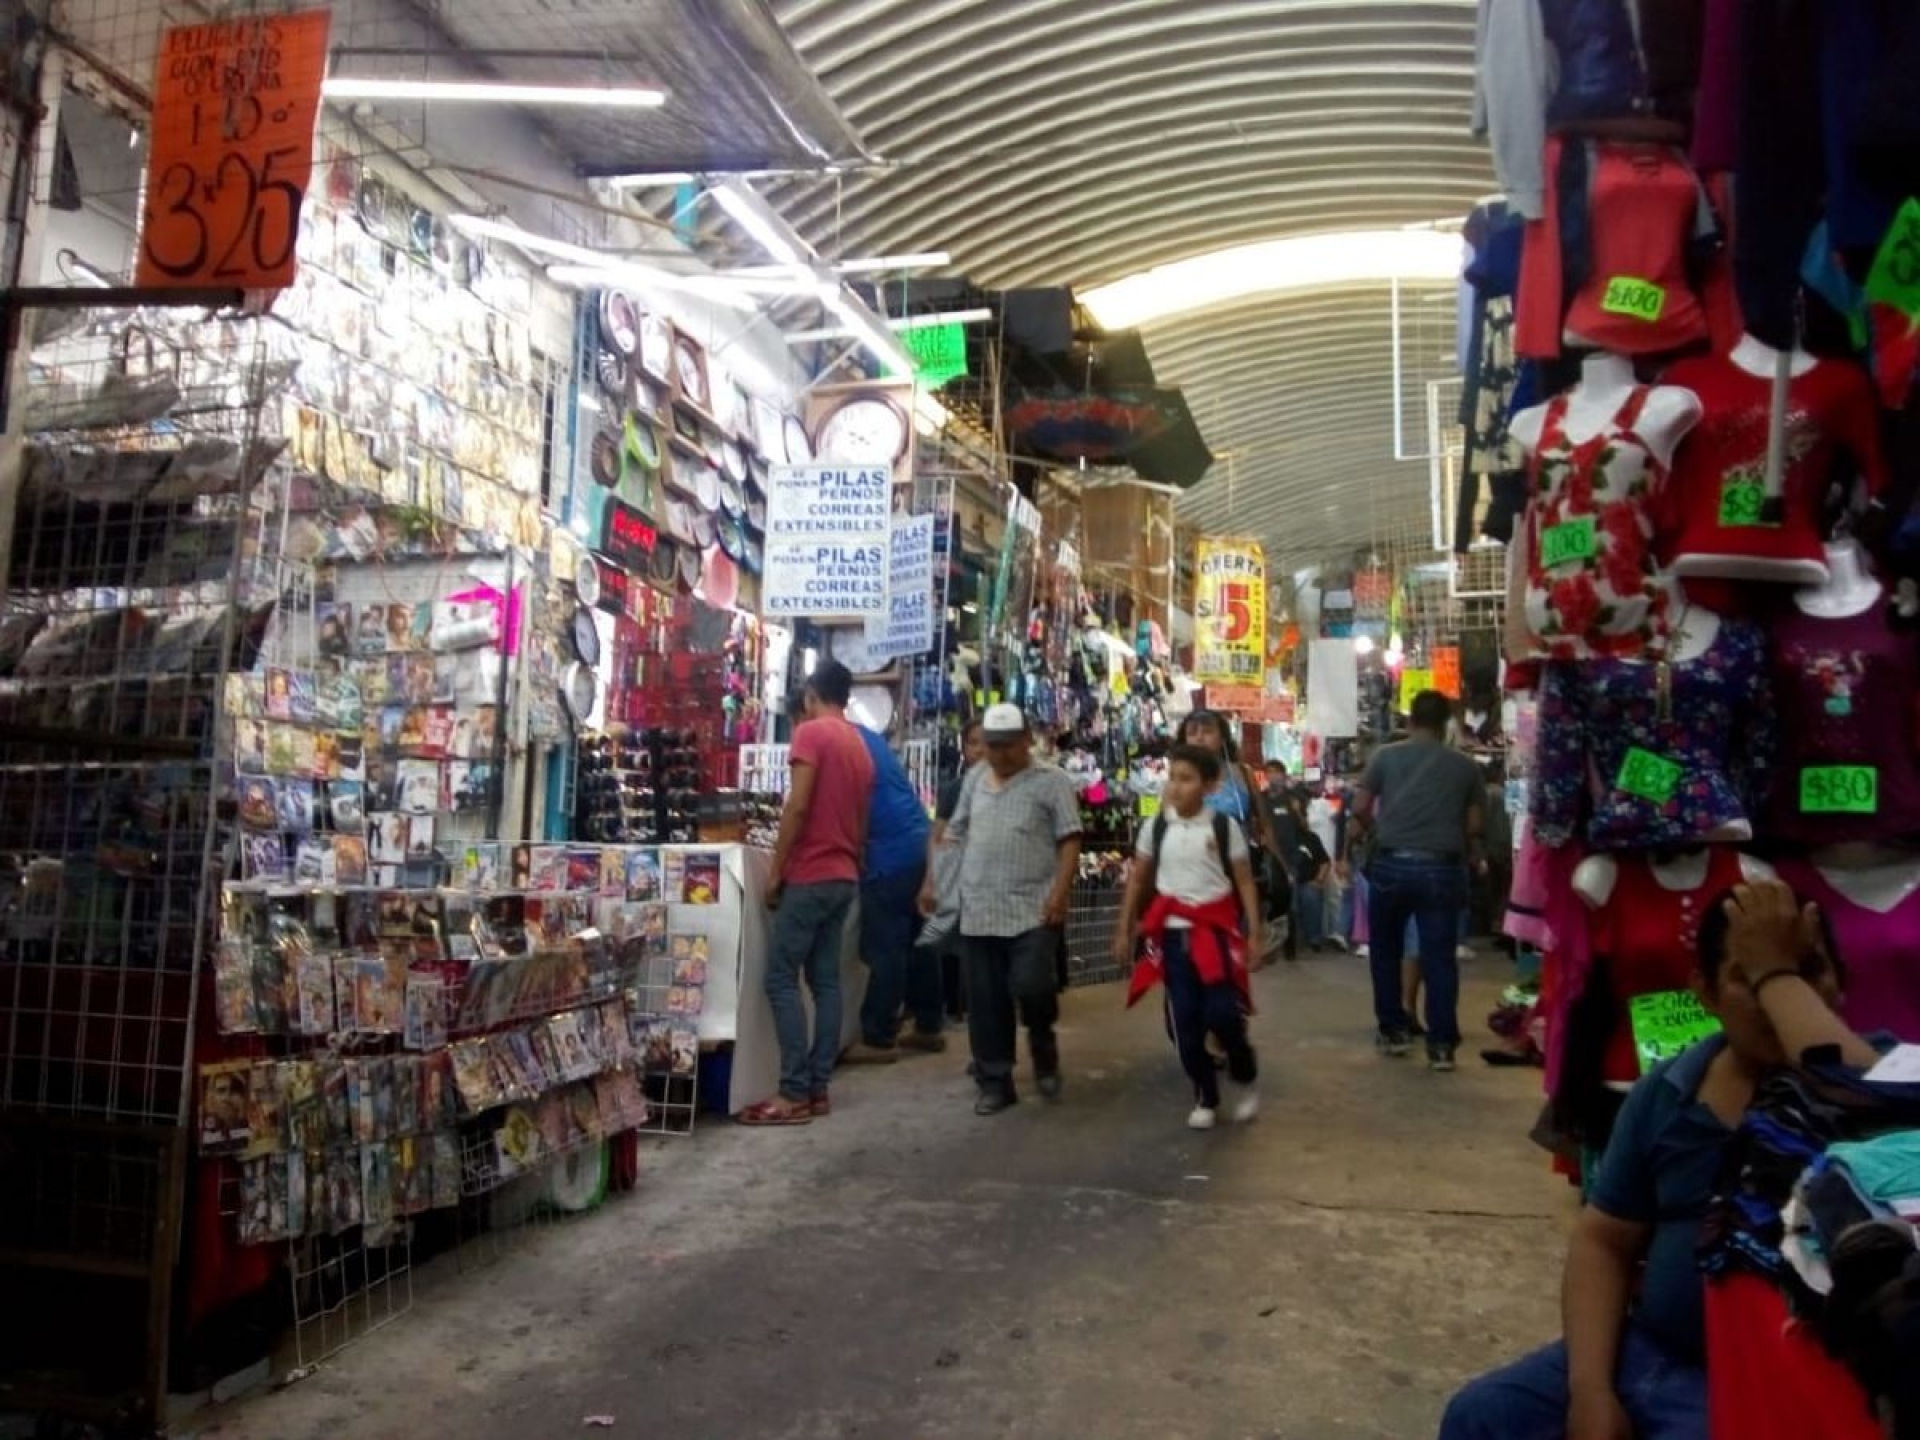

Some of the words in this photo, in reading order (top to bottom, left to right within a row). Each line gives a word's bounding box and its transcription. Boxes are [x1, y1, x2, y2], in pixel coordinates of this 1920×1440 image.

[819, 471, 885, 486] PILAS
[819, 487, 884, 500] PERNOS
[807, 503, 884, 516] CORREAS
[774, 520, 884, 532] EXTENSIBLES
[817, 547, 882, 563] PILAS
[816, 565, 882, 576] PERNOS
[804, 580, 883, 592] CORREAS
[770, 597, 882, 609] EXTENSIBLES
[1214, 582, 1250, 641] 5
[1804, 768, 1874, 808] $80
